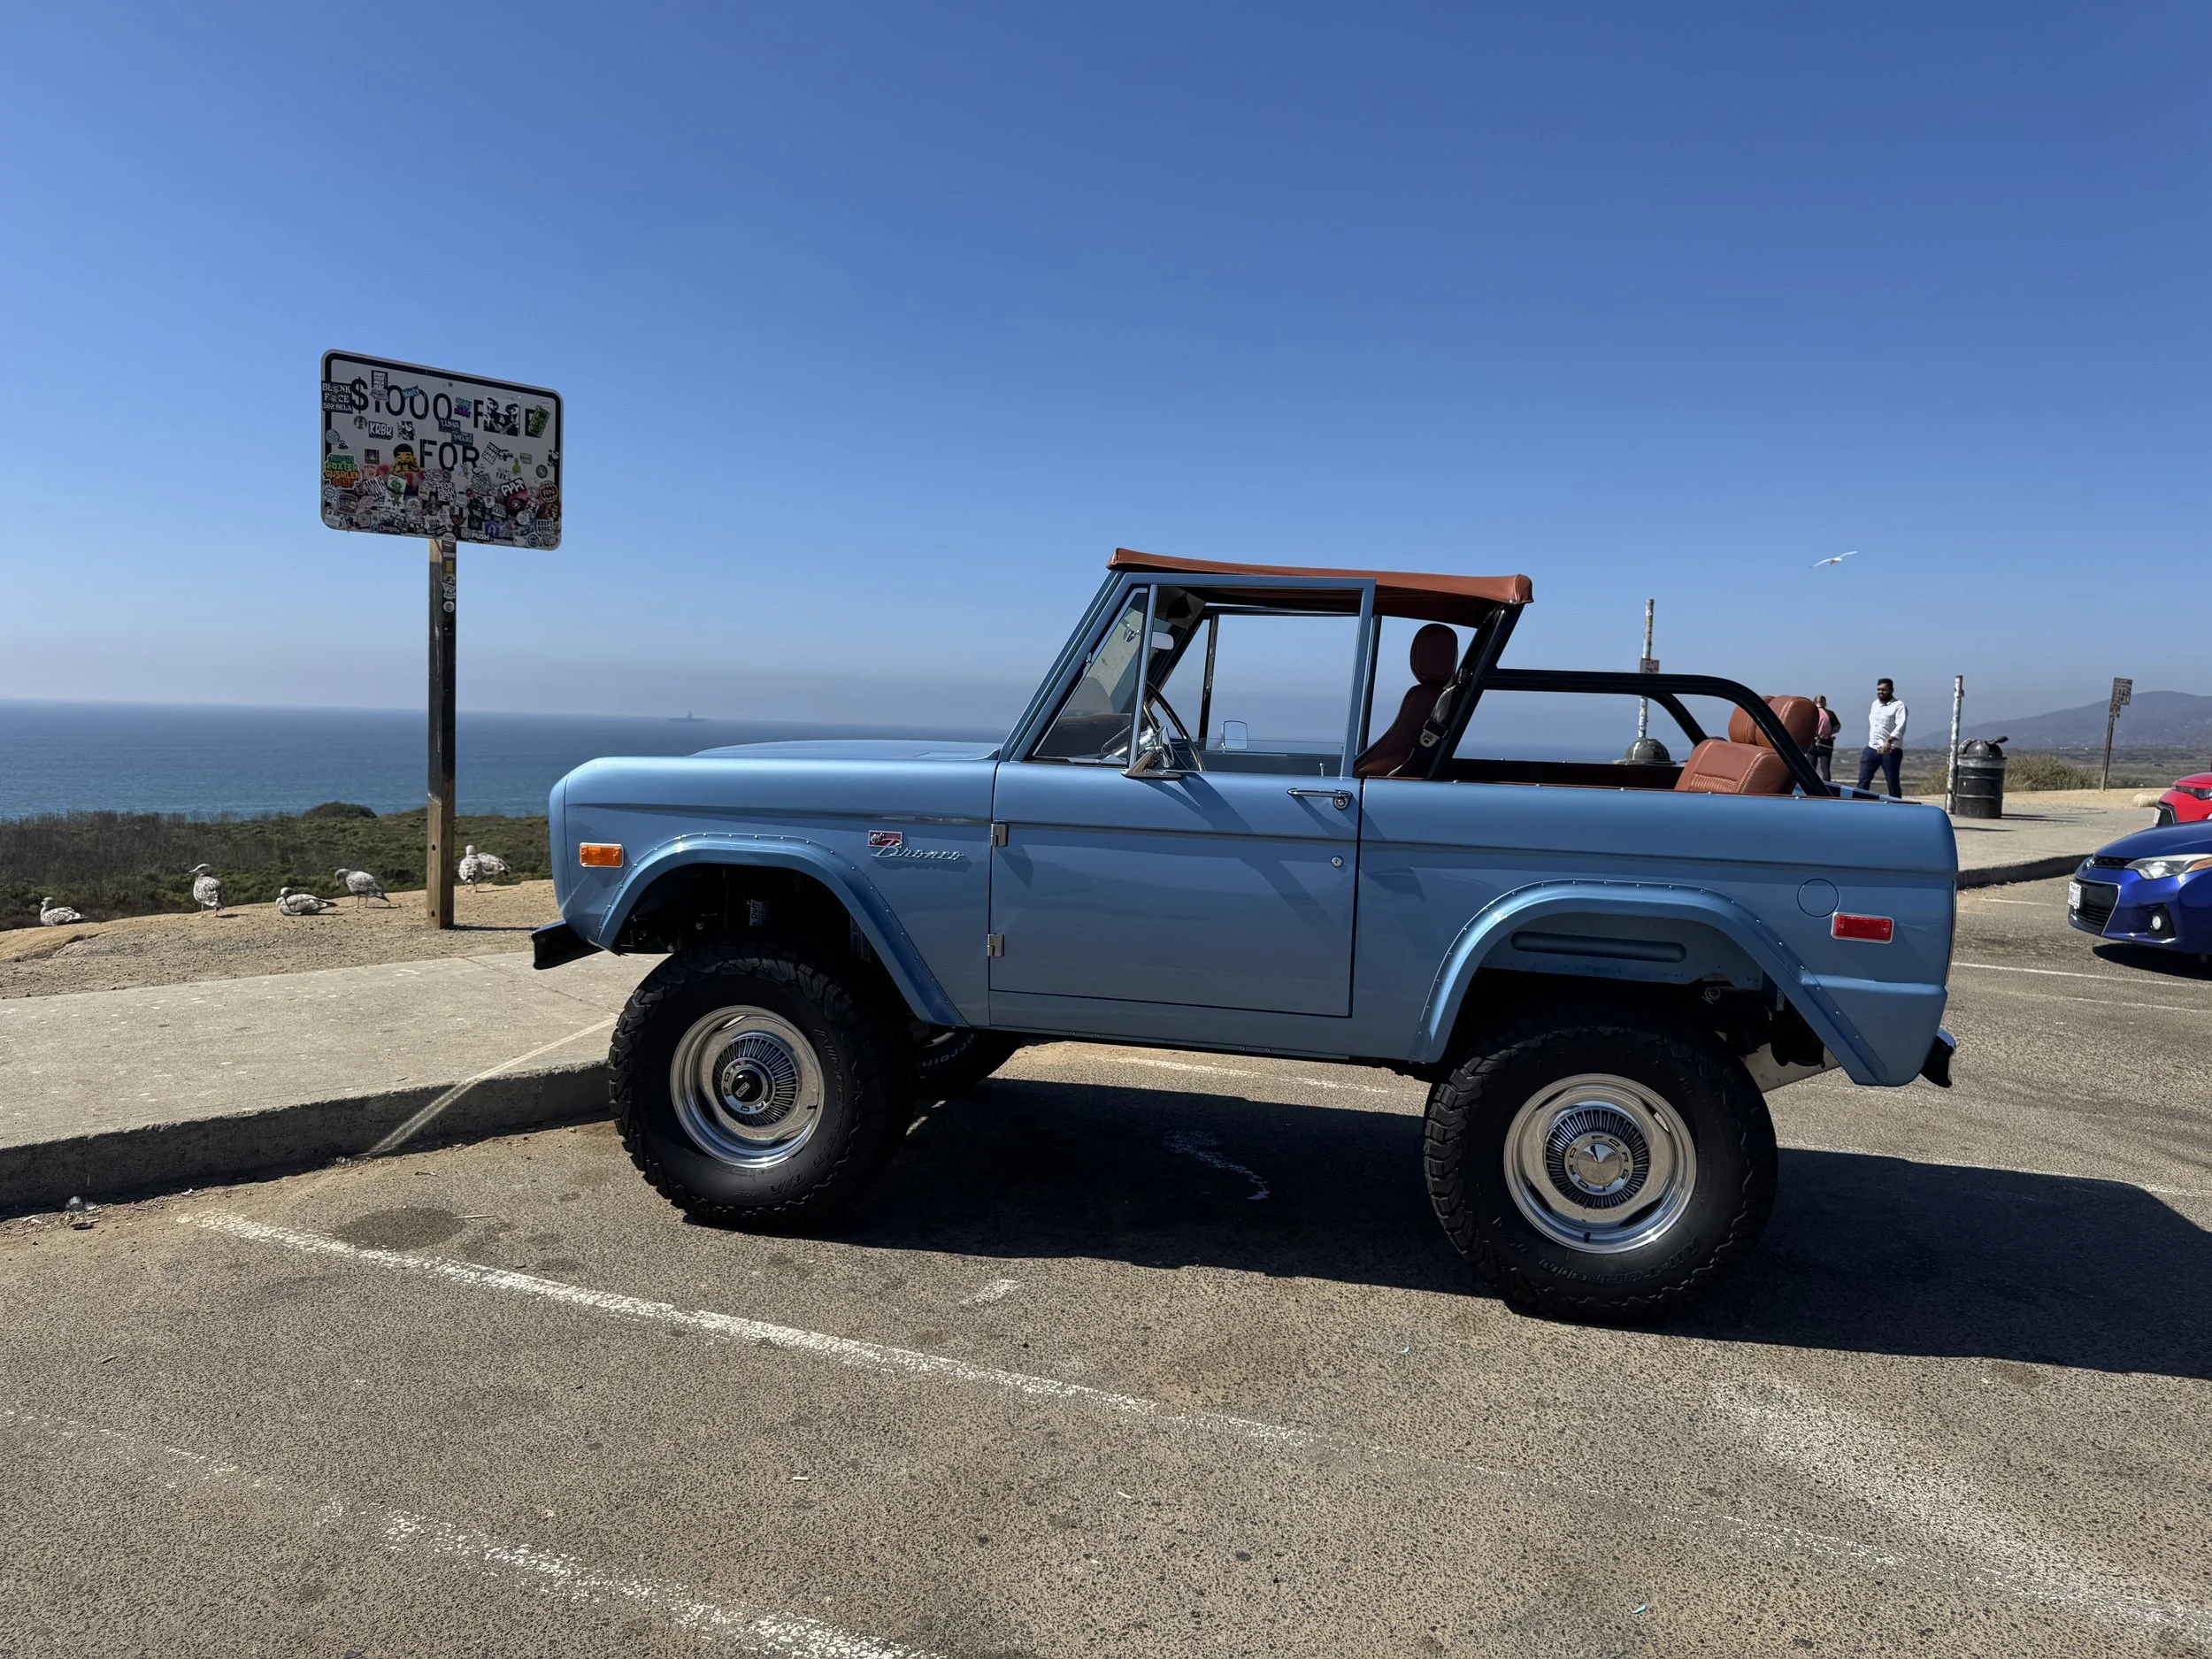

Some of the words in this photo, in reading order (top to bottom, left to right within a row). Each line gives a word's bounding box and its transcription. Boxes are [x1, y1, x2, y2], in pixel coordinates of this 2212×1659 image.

[370, 422, 392, 436] KRBR
[420, 439, 482, 471] FOR
[871, 838, 964, 860] Bronco
[1592, 1135, 1629, 1179] FORD
